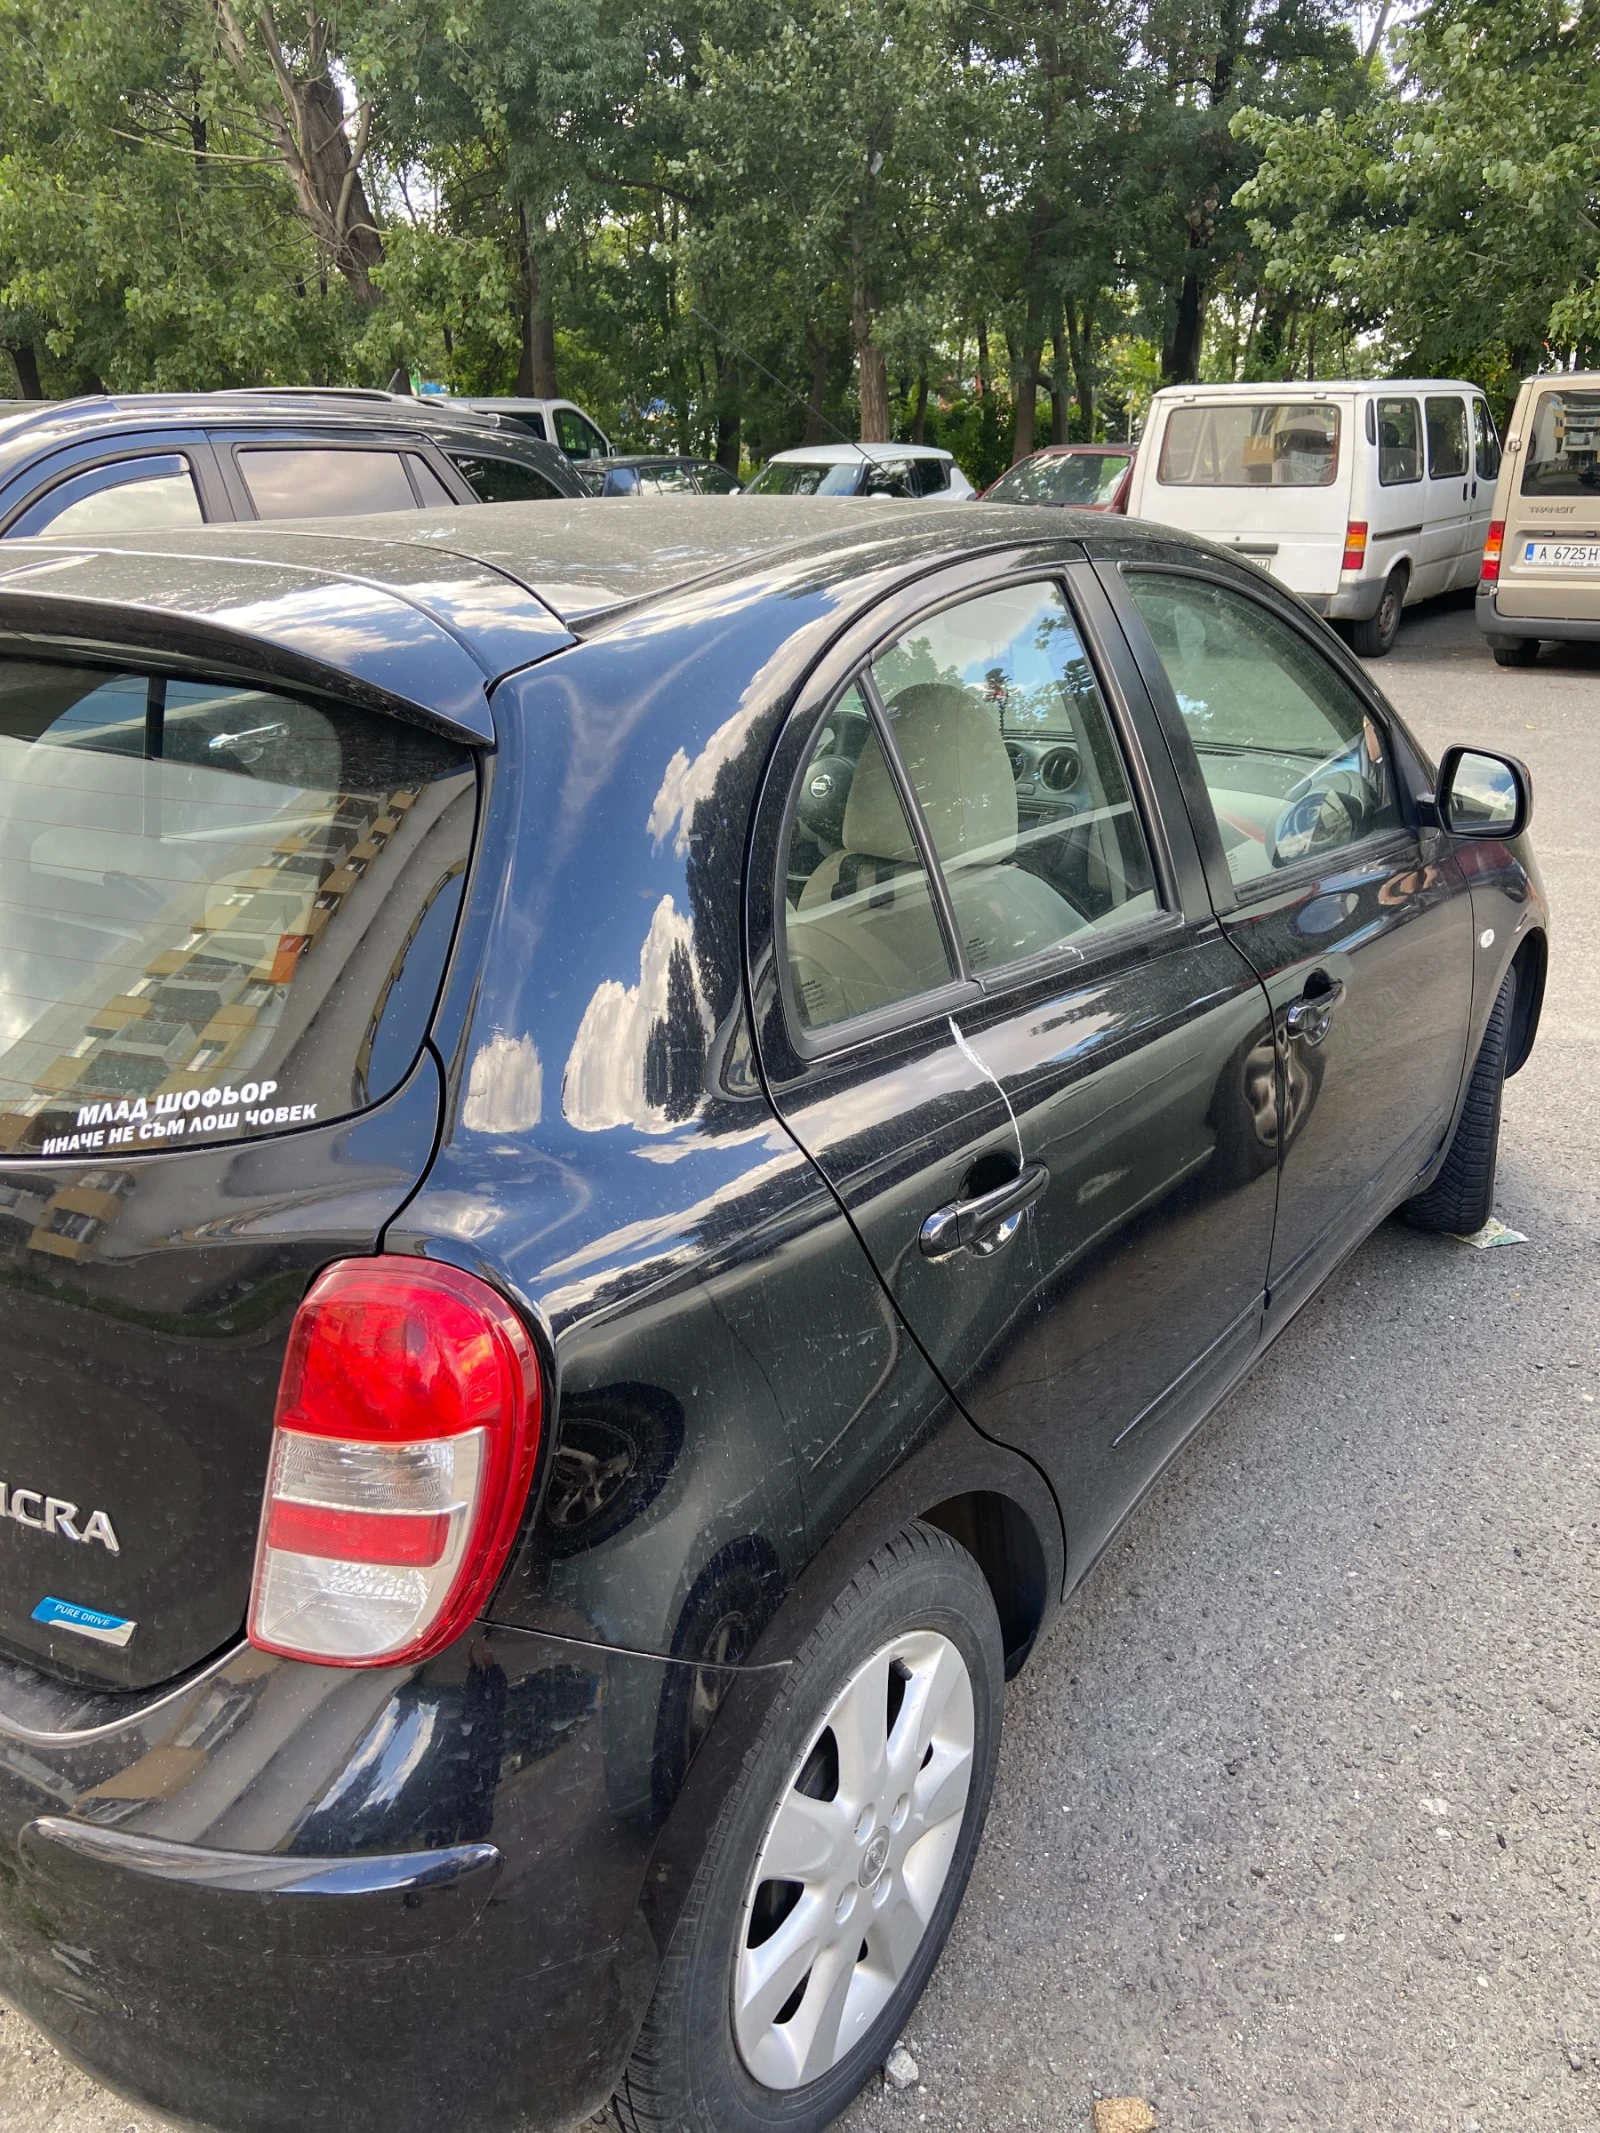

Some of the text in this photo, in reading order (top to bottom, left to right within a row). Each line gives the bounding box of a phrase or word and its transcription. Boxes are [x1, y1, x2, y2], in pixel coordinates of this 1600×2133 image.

[1528, 505, 1576, 514] TRANSIT
[1539, 546, 1547, 560] A
[77, 1080, 278, 1127] МЛАД ШОФЬОР
[42, 1129, 104, 1155] ИНАЧЕ
[108, 1125, 134, 1145] НЕ
[188, 1111, 239, 1133] ЛОШ
[245, 1103, 318, 1126] ЧОВЕК
[54, 1604, 111, 1627] PURE DRIVE
